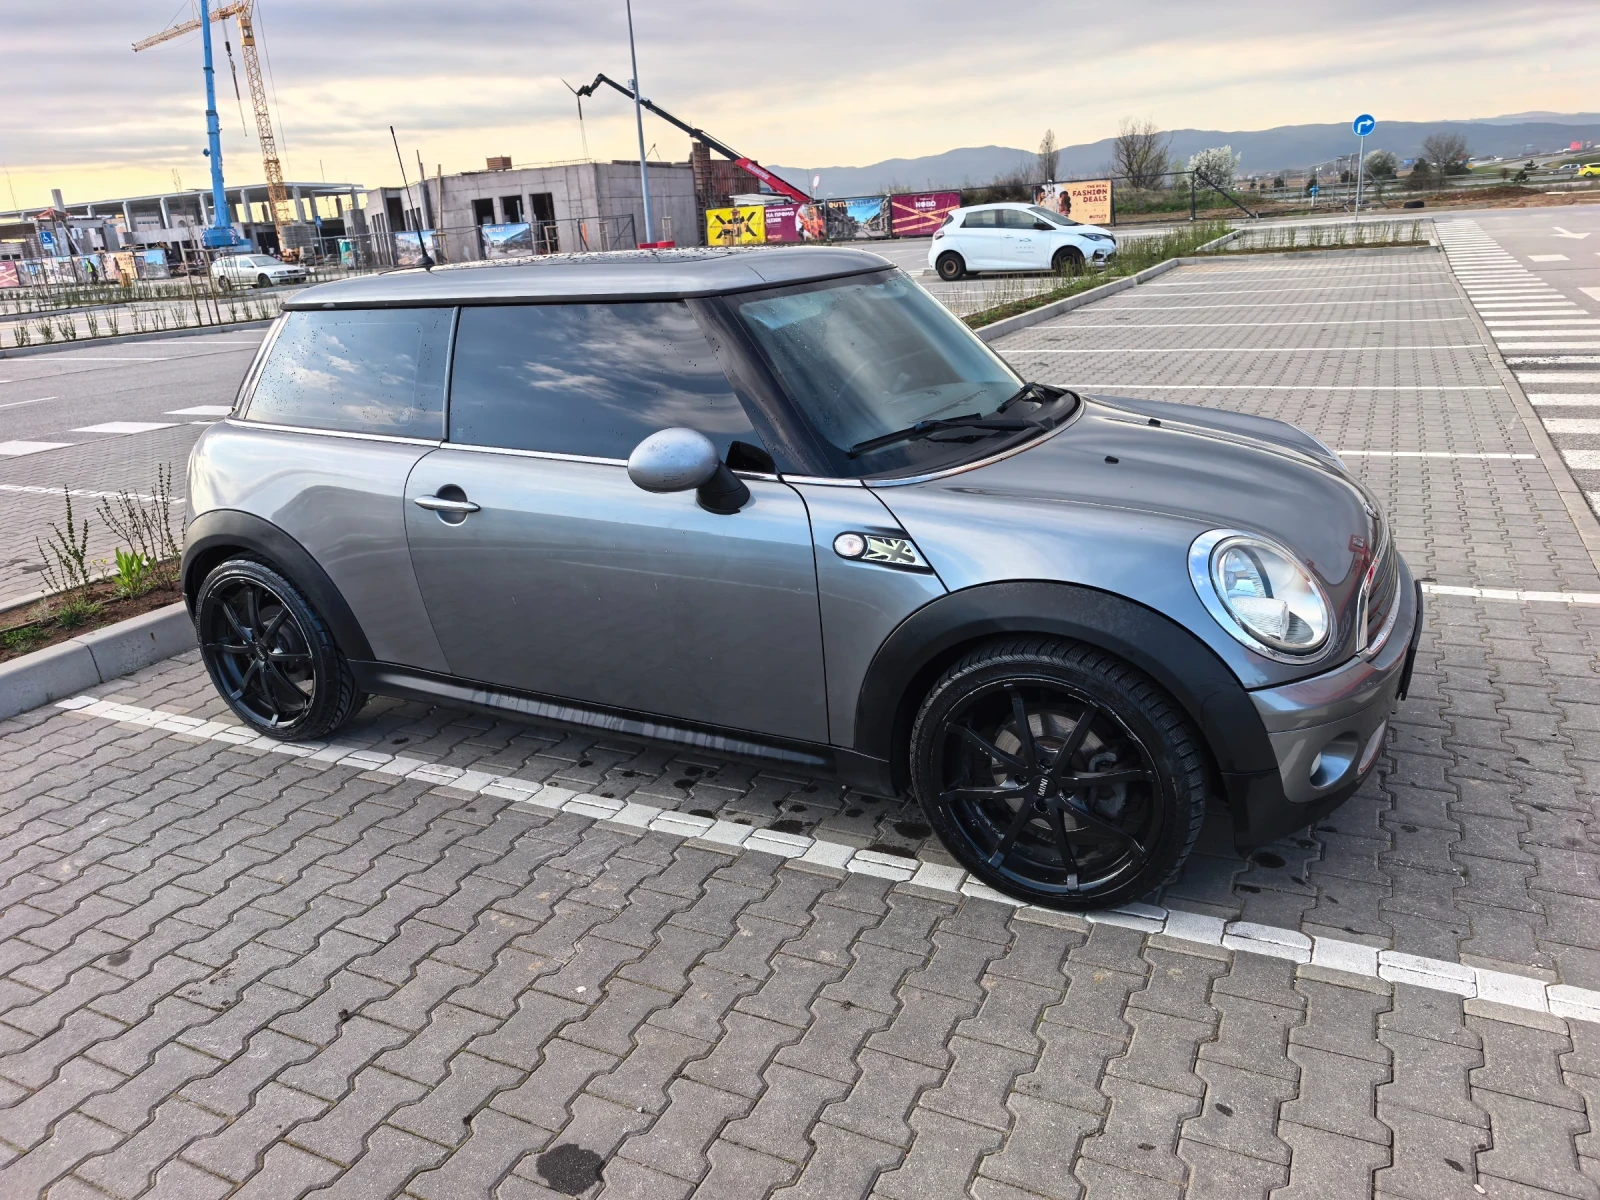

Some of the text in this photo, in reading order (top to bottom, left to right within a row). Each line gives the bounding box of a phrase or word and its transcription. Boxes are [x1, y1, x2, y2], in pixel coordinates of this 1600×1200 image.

[1072, 189, 1107, 197] FASHION
[828, 200, 854, 208] OUTLET
[1037, 778, 1048, 796] MINI
